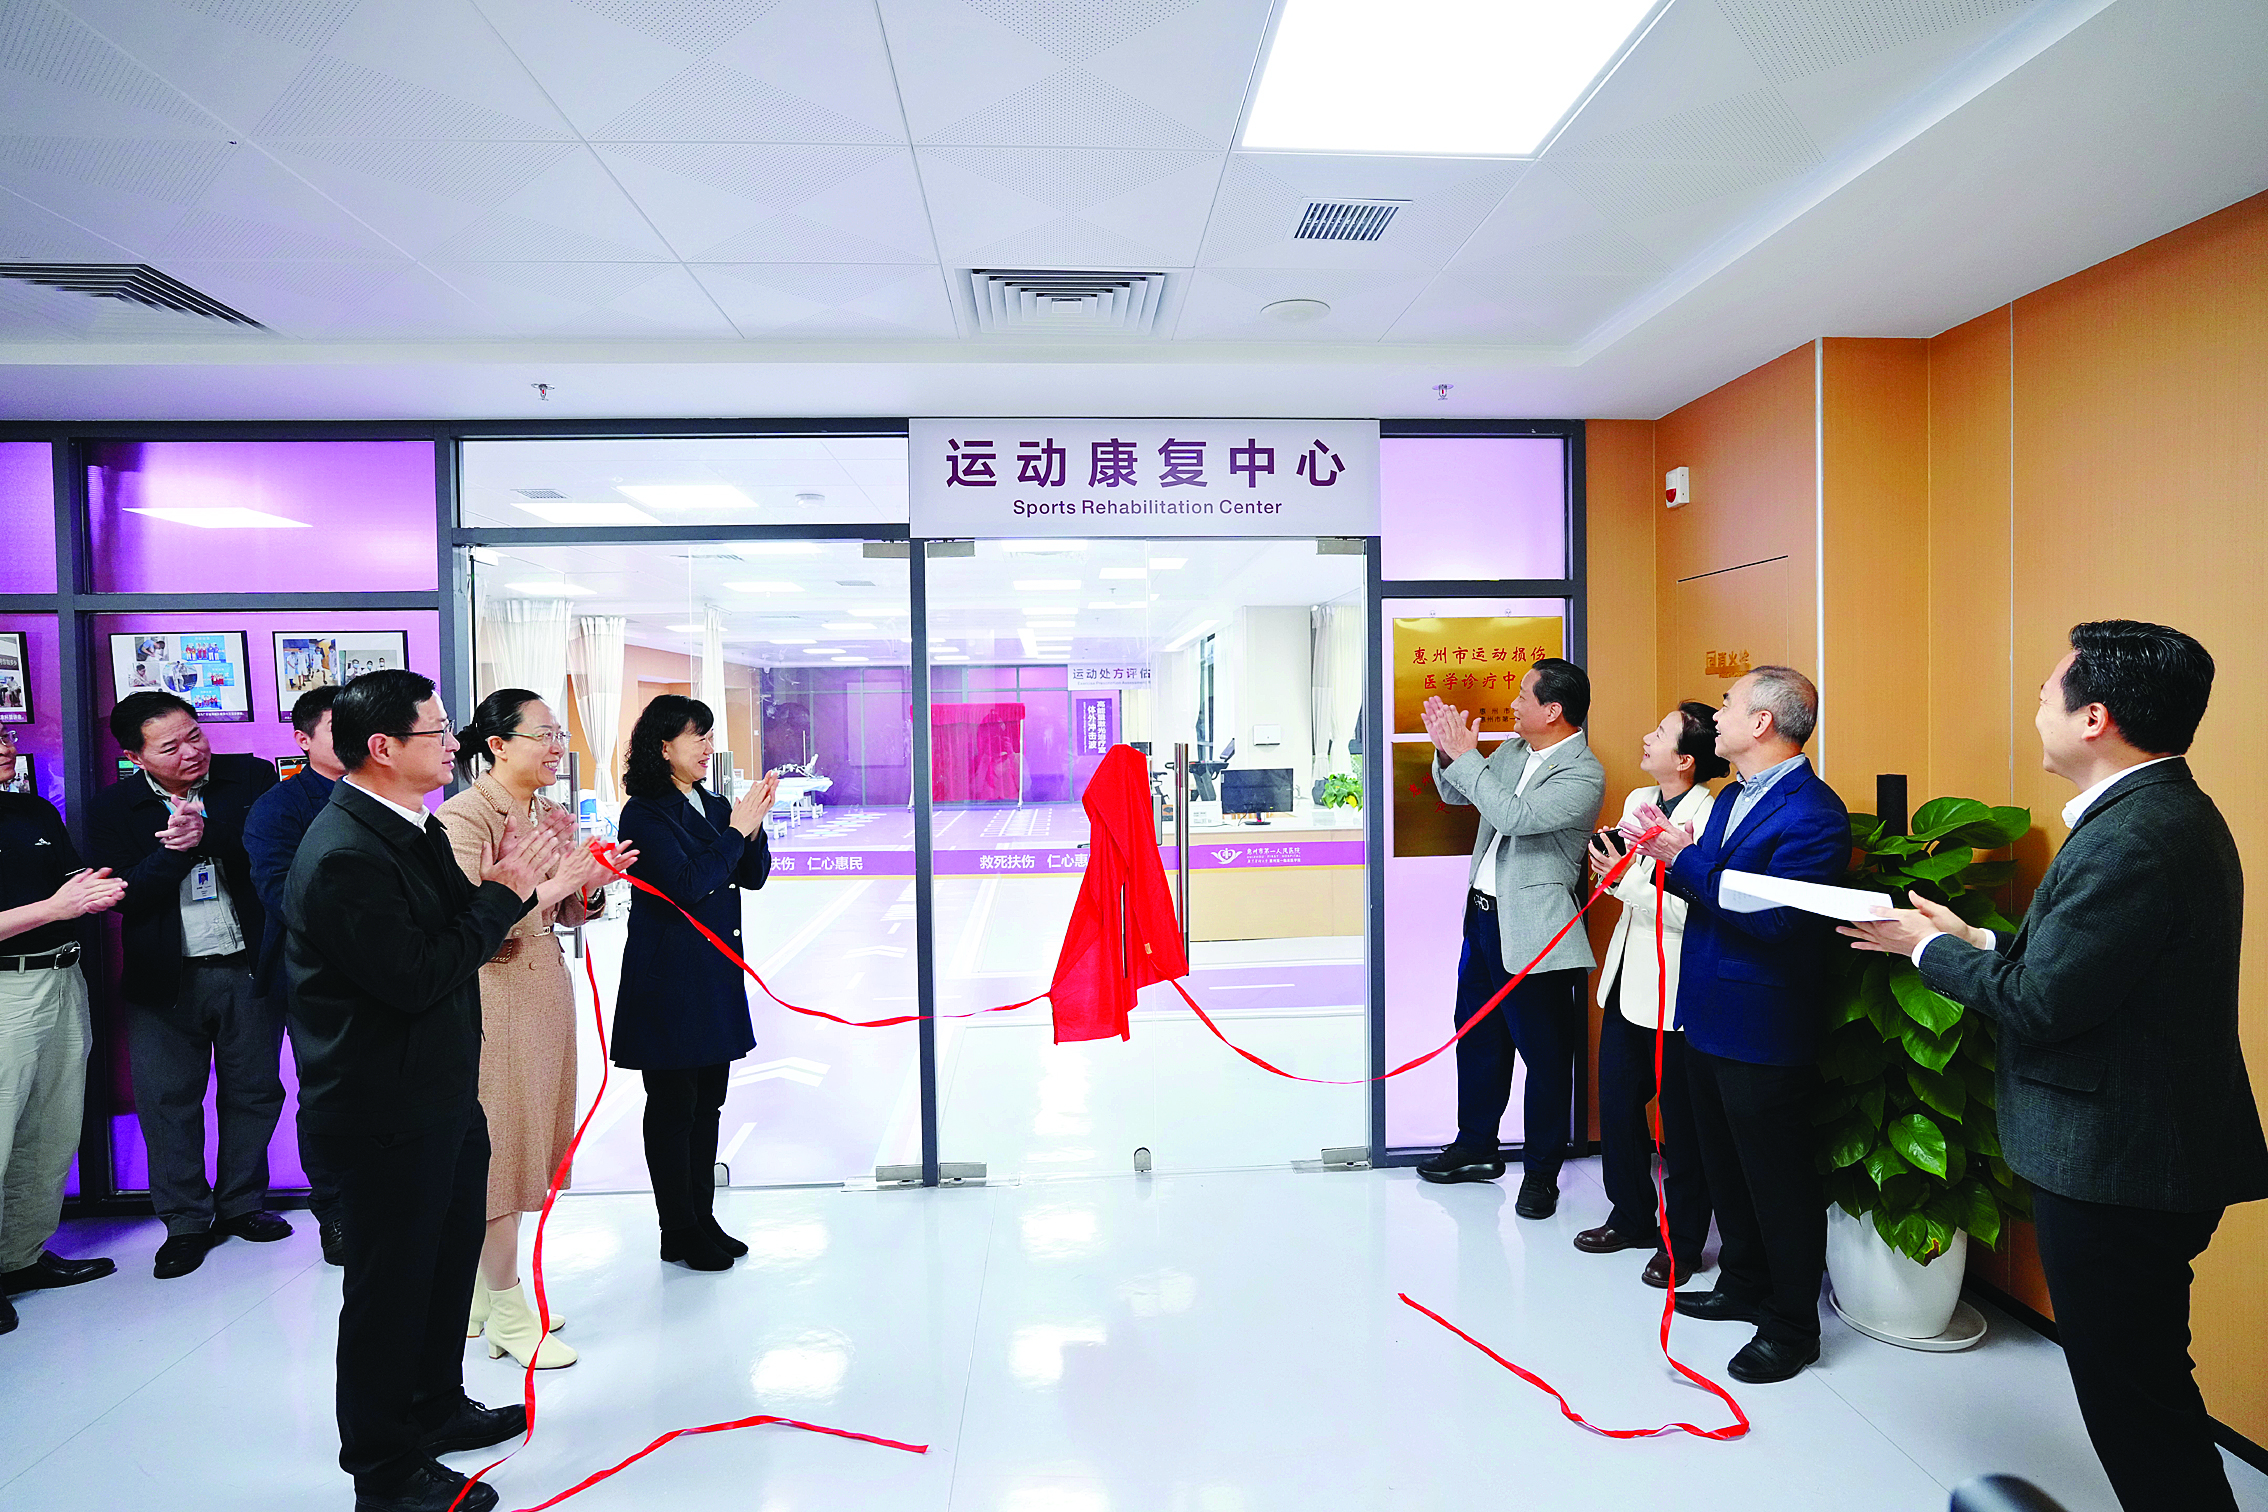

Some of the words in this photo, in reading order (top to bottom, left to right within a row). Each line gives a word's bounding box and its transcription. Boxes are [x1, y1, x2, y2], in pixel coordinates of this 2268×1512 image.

[945, 438, 1346, 488] 运动康复中心
[1013, 499, 1077, 519] Sports
[1082, 499, 1214, 515] Rehabilitation
[1219, 499, 1283, 515] Center
[1412, 646, 1547, 665] 惠州市运动损伤
[1072, 667, 1151, 680] 运动处方评估
[1424, 671, 1523, 690] 医学诊疗中
[1087, 705, 1097, 749] 体外冲击波
[807, 856, 864, 871] 仁心惠民
[979, 854, 1036, 869] 救死扶伤
